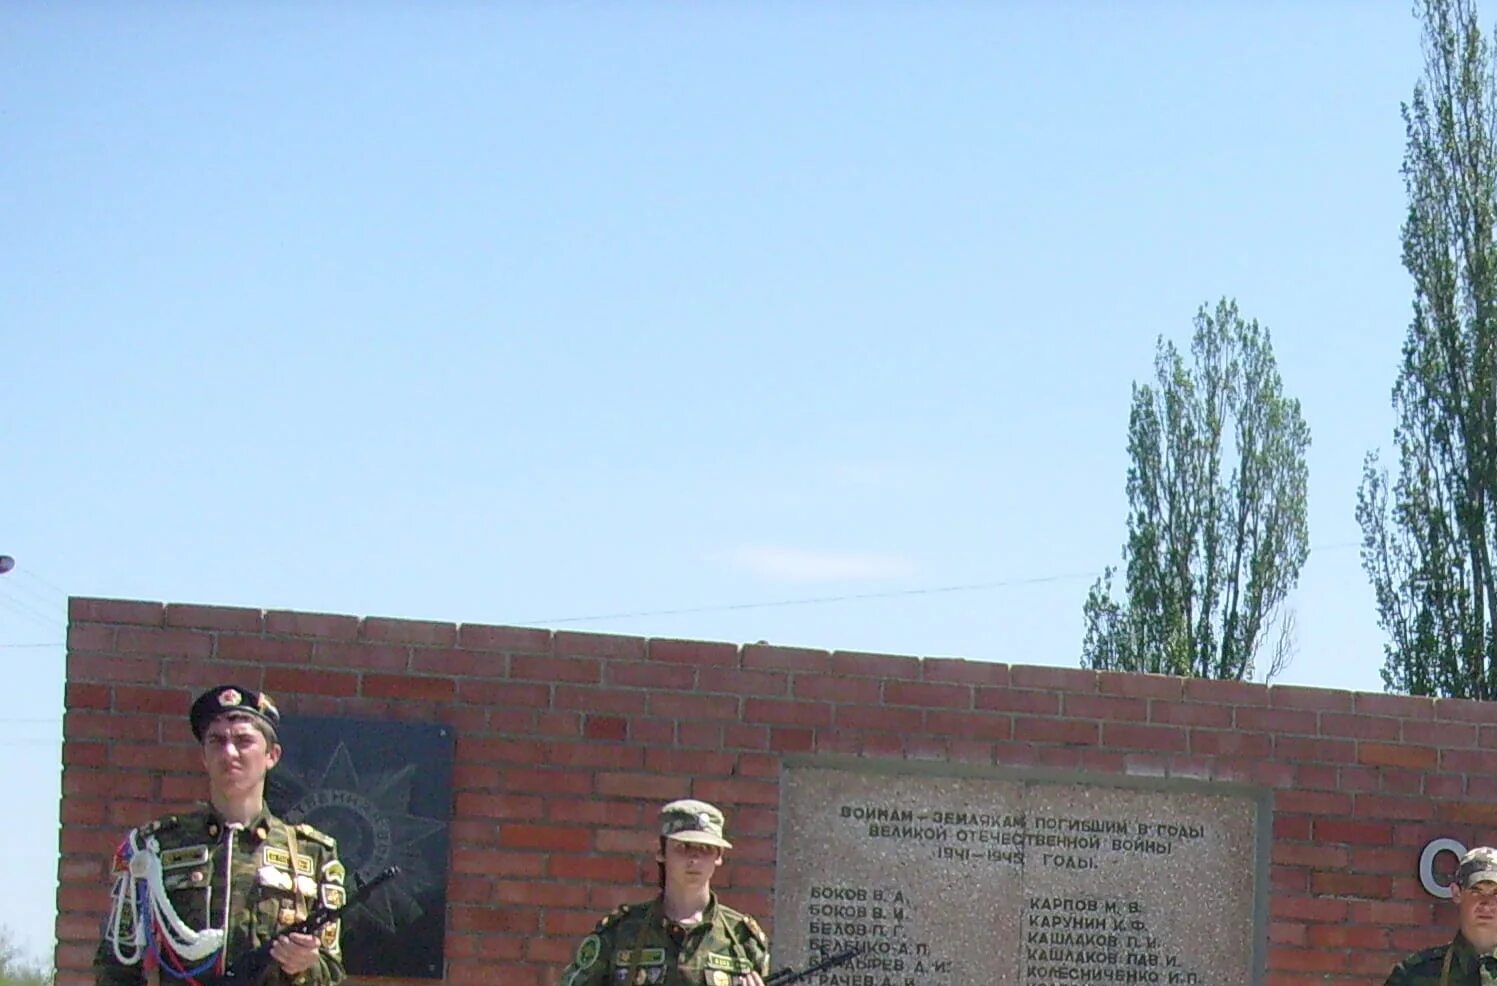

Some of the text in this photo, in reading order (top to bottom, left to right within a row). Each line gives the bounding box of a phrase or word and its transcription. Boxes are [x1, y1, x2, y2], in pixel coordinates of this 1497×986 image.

[1035, 817, 1127, 835] ПОГИБШИМ
[1138, 824, 1149, 835] В
[1157, 825, 1204, 838] ГОДЫ
[868, 824, 1172, 854] ВЕЛИКОЙ ОТЕЧЕСТВЕННОЙ ВОЙНЫ
[810, 887, 868, 901] БОКОВ
[809, 904, 868, 918] БОКОВ
[1030, 898, 1098, 912] КАРПОВ
[809, 922, 867, 936] БЕЛОВ
[1029, 915, 1106, 930] КАРУНИН
[1028, 932, 1118, 947] КАШЛАКОВ
[1027, 948, 1118, 964] КАШЛАКОВ
[1027, 966, 1159, 984] КОЛЕСНИЧЕНКО
